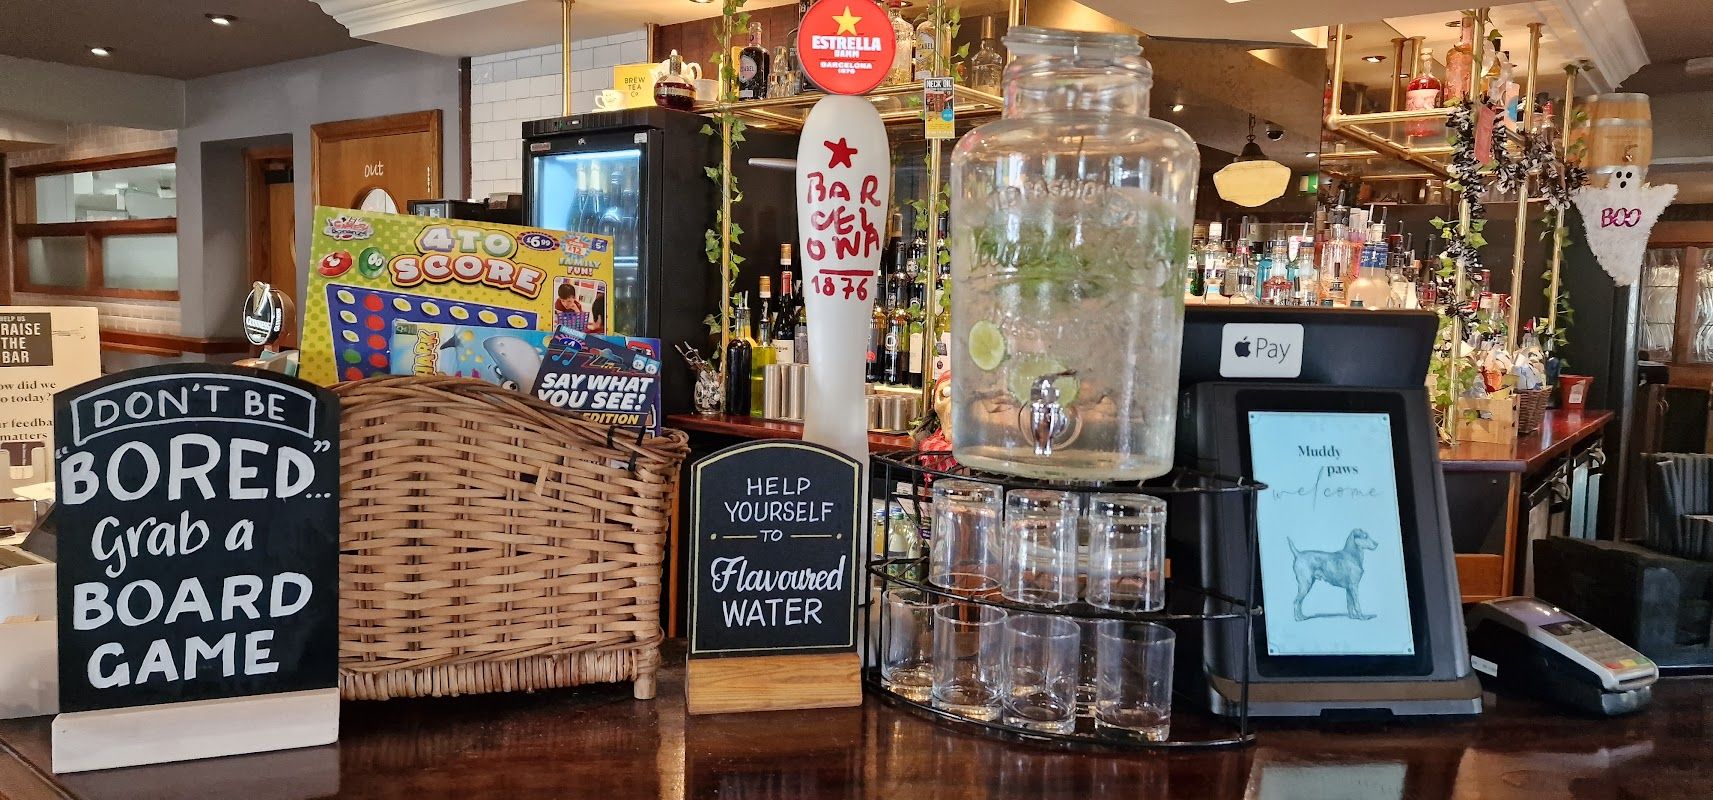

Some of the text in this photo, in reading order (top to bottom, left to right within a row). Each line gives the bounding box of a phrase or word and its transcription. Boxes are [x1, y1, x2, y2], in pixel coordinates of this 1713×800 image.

[812, 35, 881, 51] ESTRELLA
[820, 61, 872, 69] BARCELONA
[926, 80, 941, 88] NECK
[365, 160, 384, 178] out
[1601, 207, 1642, 228] BOO
[559, 257, 601, 268] FAMILY
[567, 266, 593, 276] FUN!
[393, 254, 543, 295] SCORE
[811, 275, 869, 301] 1876
[1, 322, 41, 336] RAISE
[1, 337, 27, 350] THE
[1256, 337, 1291, 364] Pay
[2, 350, 30, 364] BAR
[414, 330, 438, 377] HARK
[18, 380, 37, 390] did
[541, 372, 654, 393] SAY WHAT
[11, 393, 52, 404] today?
[94, 383, 286, 428] DON'T BE
[537, 389, 647, 411] YOU SEE!
[11, 418, 54, 428] feedba
[582, 412, 640, 425] EDITION
[0, 433, 48, 441] matters
[1297, 445, 1341, 460] Muddy
[1326, 465, 1358, 477] paws
[746, 476, 811, 496] HELP
[1272, 466, 1381, 512] welcome
[724, 501, 834, 522] YOURSELF
[92, 509, 255, 578] Grab a
[760, 529, 783, 542] TO
[710, 555, 847, 593] Flavoured
[73, 571, 313, 631] BOARD
[722, 598, 823, 628] WATER
[87, 630, 281, 689] GAME
